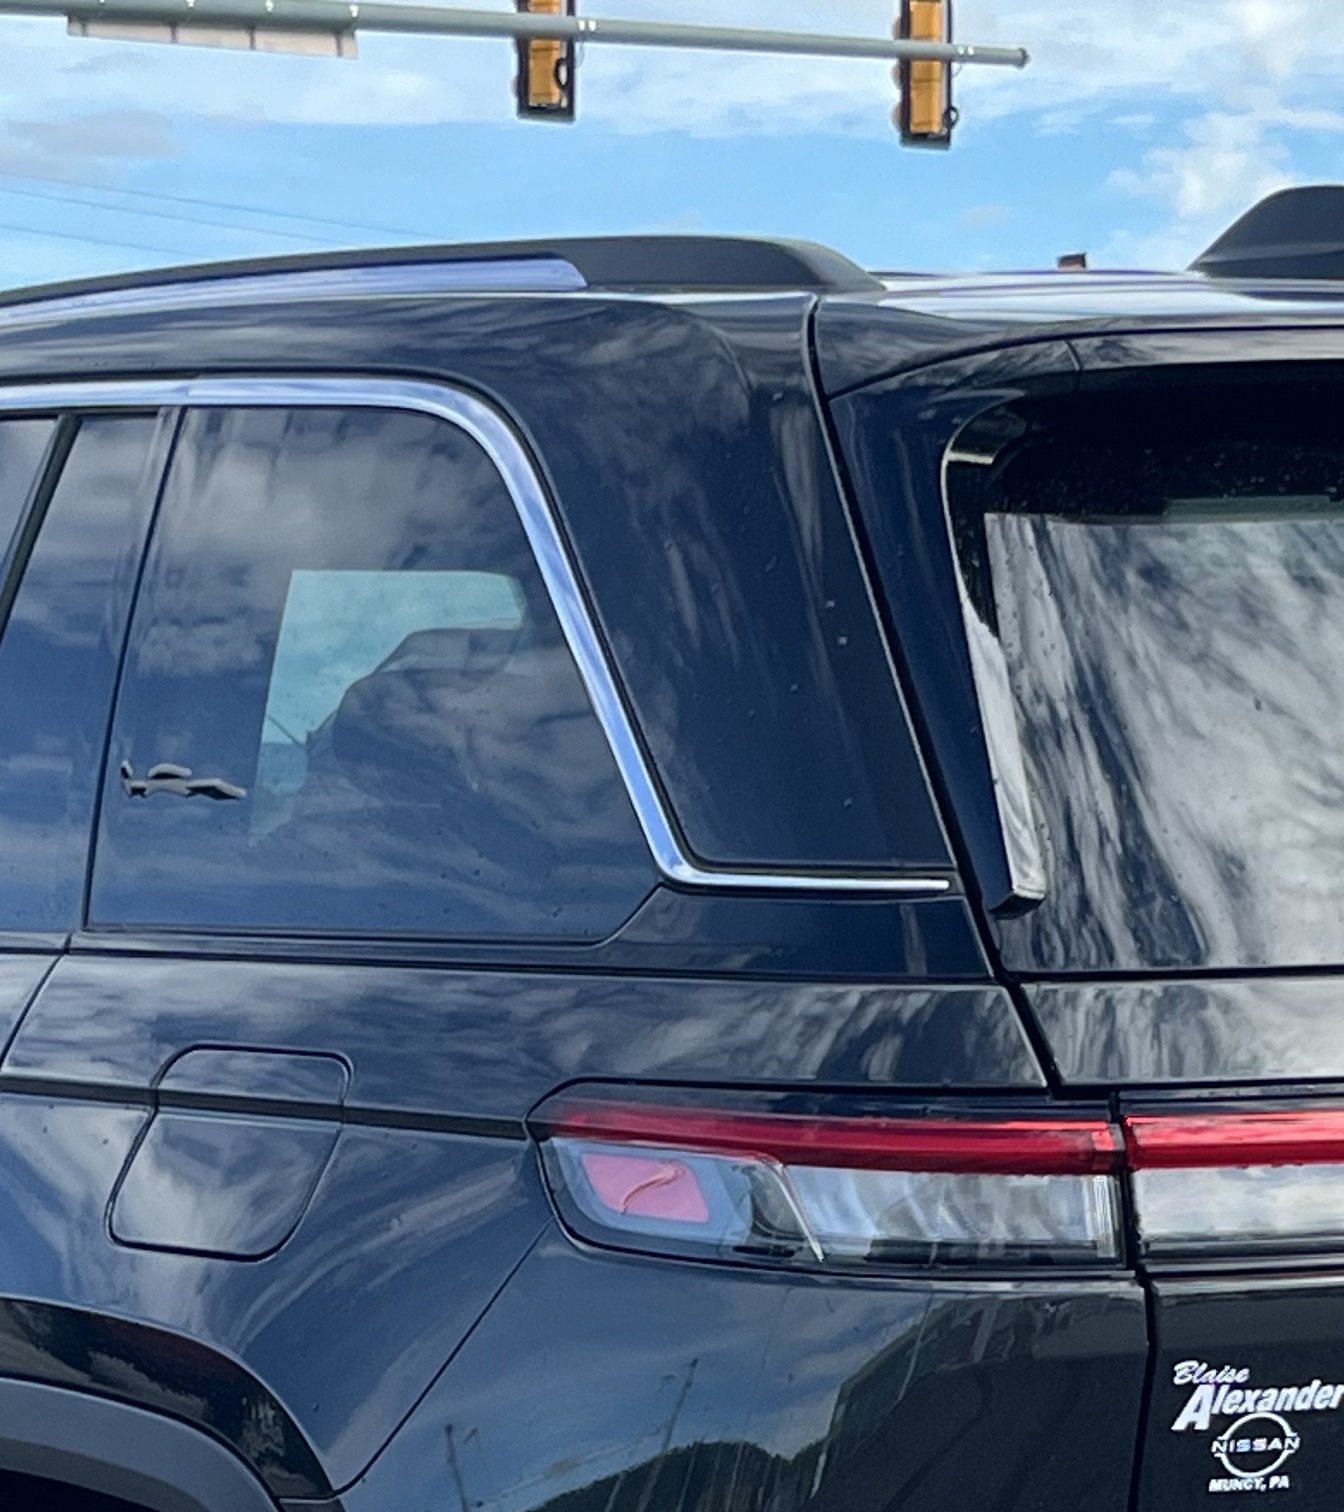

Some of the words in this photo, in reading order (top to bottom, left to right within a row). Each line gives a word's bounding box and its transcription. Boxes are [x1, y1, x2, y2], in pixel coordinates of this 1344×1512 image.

[1173, 1360, 1251, 1385] Blaise
[1210, 1435, 1301, 1453] NISSAN
[1208, 1476, 1268, 1492] MUNCY,
[1269, 1475, 1290, 1489] PA
